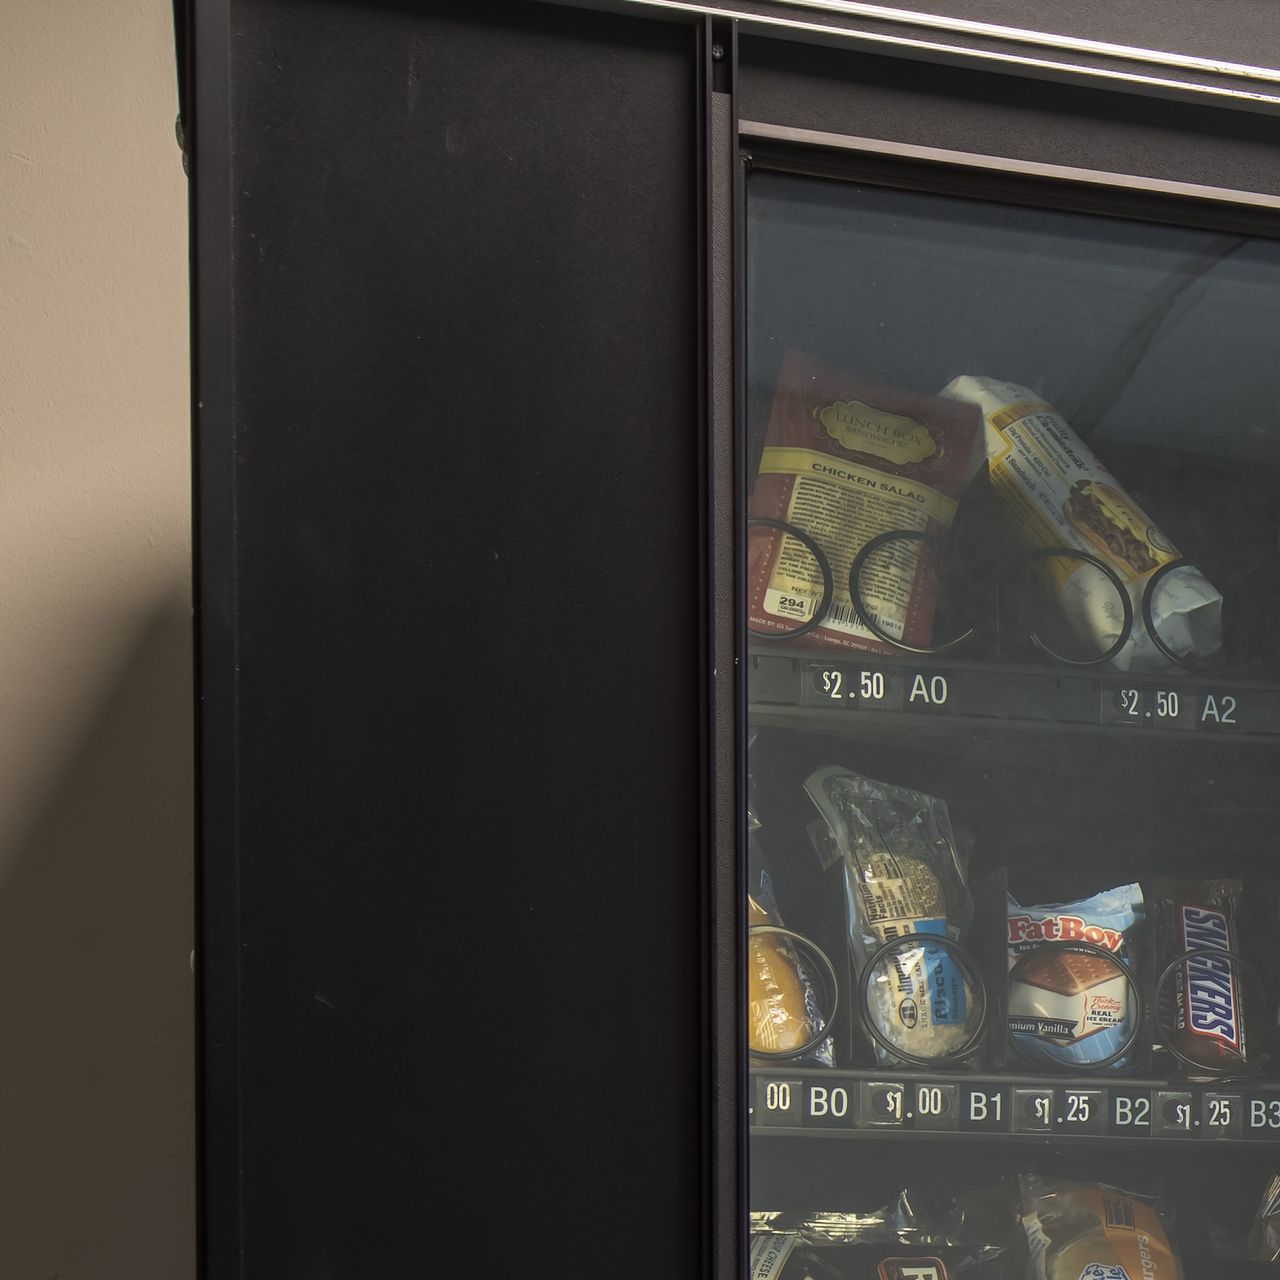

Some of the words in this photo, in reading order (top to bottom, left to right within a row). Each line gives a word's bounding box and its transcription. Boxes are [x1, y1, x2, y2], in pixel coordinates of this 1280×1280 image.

[811, 463, 878, 488] CHICKEN
[880, 482, 925, 503] SALAD
[779, 596, 804, 609] 294
[822, 671, 885, 700] $2.50
[909, 674, 948, 703] A0
[1037, 1021, 1069, 1034] Vanilla
[1035, 1095, 1090, 1124] $1.25
[1115, 1098, 1150, 1125] B2
